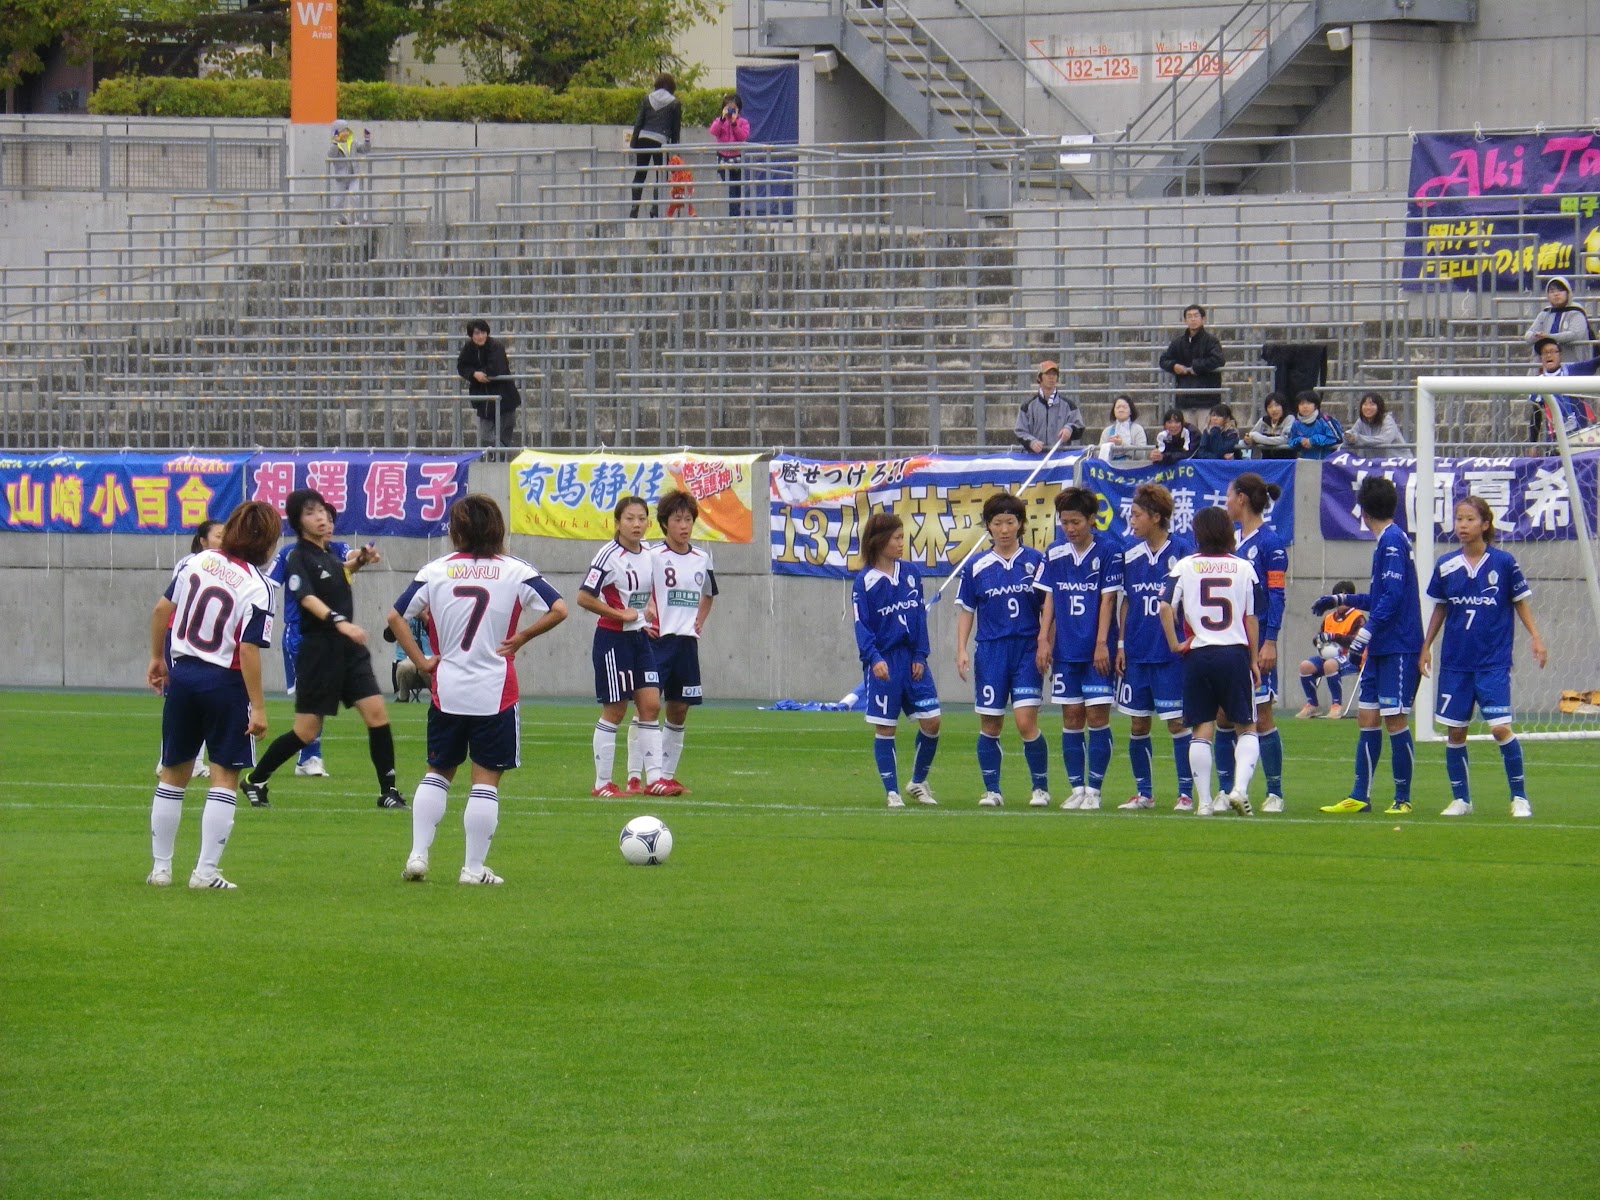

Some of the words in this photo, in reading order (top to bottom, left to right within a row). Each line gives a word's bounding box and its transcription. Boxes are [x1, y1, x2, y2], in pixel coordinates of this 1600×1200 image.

[297, 2, 325, 26] W
[312, 31, 333, 39] Area
[1414, 145, 1525, 208] Aki
[518, 460, 664, 511] 有馬静佳
[7, 474, 215, 528] 山崎小百合
[203, 557, 247, 590] MARUI
[450, 564, 500, 580] MARUI
[664, 567, 677, 588] 8
[1198, 562, 1238, 574] MARUI
[625, 570, 640, 591] 11
[984, 583, 1035, 598] TAMURA
[1007, 597, 1020, 618] 9
[1069, 595, 1086, 616] 15
[1142, 596, 1160, 616] 10
[1200, 577, 1233, 632] 5
[1448, 596, 1498, 606] TAMURA
[176, 572, 235, 653] 10
[452, 585, 491, 652] 7
[1465, 609, 1476, 630] 7
[898, 614, 910, 633] 4
[618, 669, 635, 692] 11
[1051, 673, 1066, 694] 15
[875, 694, 889, 715] 4
[982, 685, 995, 705] 9
[1119, 683, 1133, 705] 10
[1441, 693, 1453, 714] 7
